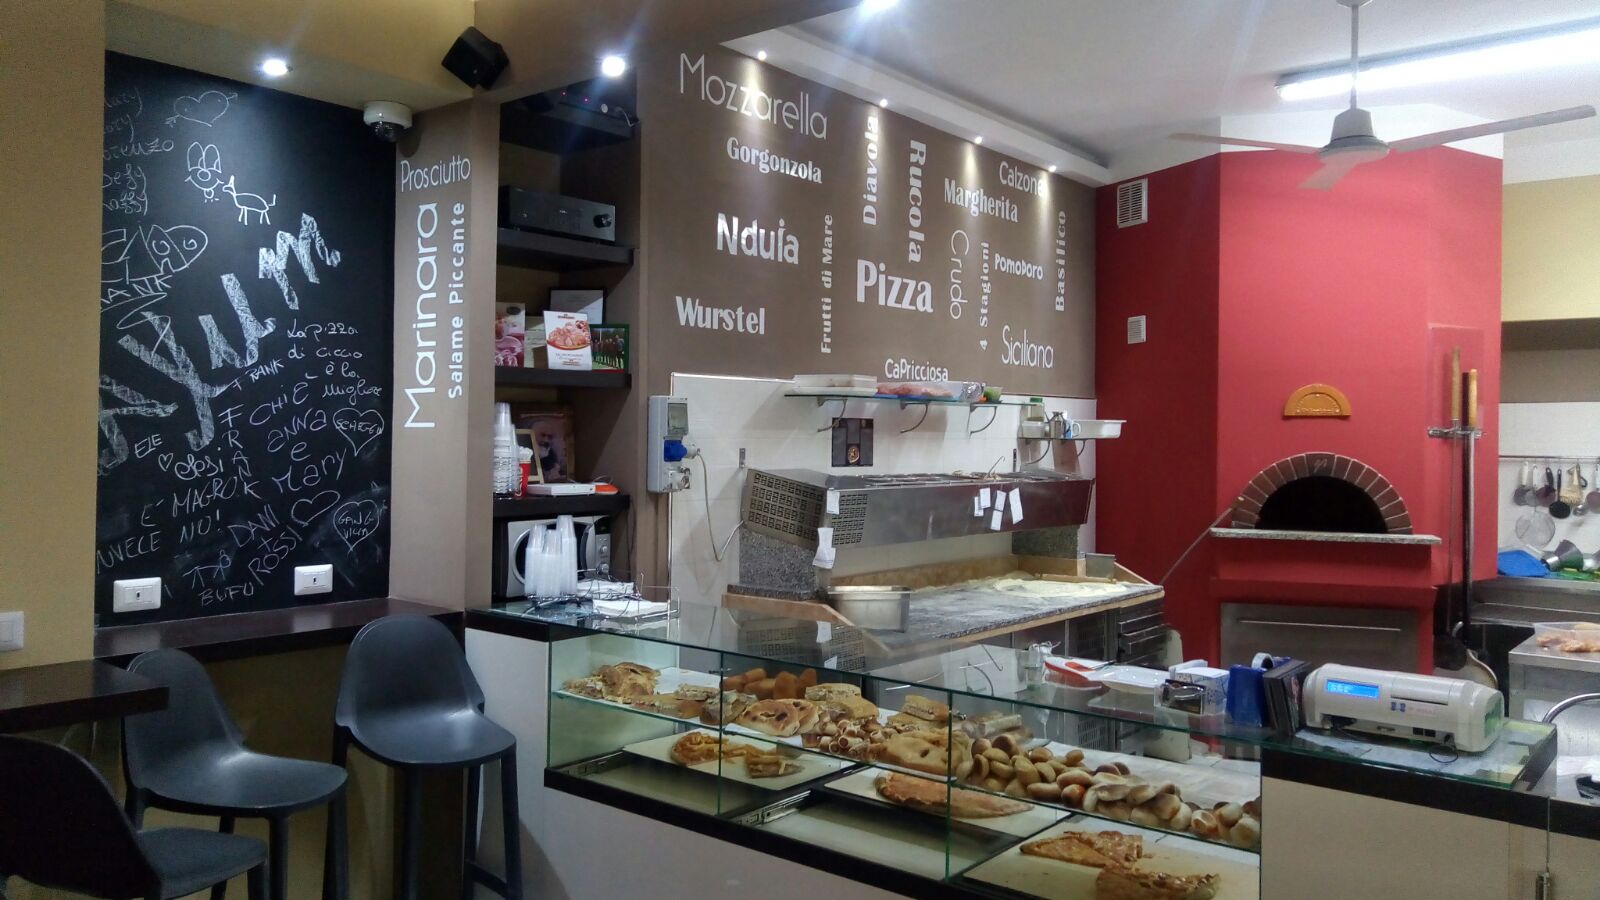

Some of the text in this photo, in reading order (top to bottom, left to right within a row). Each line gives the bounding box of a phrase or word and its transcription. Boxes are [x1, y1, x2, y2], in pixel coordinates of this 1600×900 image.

[680, 53, 828, 139] Mozzarella
[401, 158, 471, 192] Prosciutto
[726, 137, 823, 183] Gorgonzola
[863, 116, 879, 225] Diavola
[999, 161, 1046, 197] Calzone
[908, 140, 926, 263] Rucola
[944, 178, 1018, 222] Margherita
[821, 214, 833, 354] Frutti di Mare
[856, 259, 934, 313] Pizza
[950, 229, 969, 320] Crudo
[1055, 211, 1066, 312] Basilico
[404, 203, 438, 428] Marinara
[448, 202, 464, 399] Salame Piccante
[675, 295, 766, 335] Wurstel
[288, 343, 306, 359] di
[980, 339, 988, 350] 4
[1001, 325, 1054, 369] Siciliana
